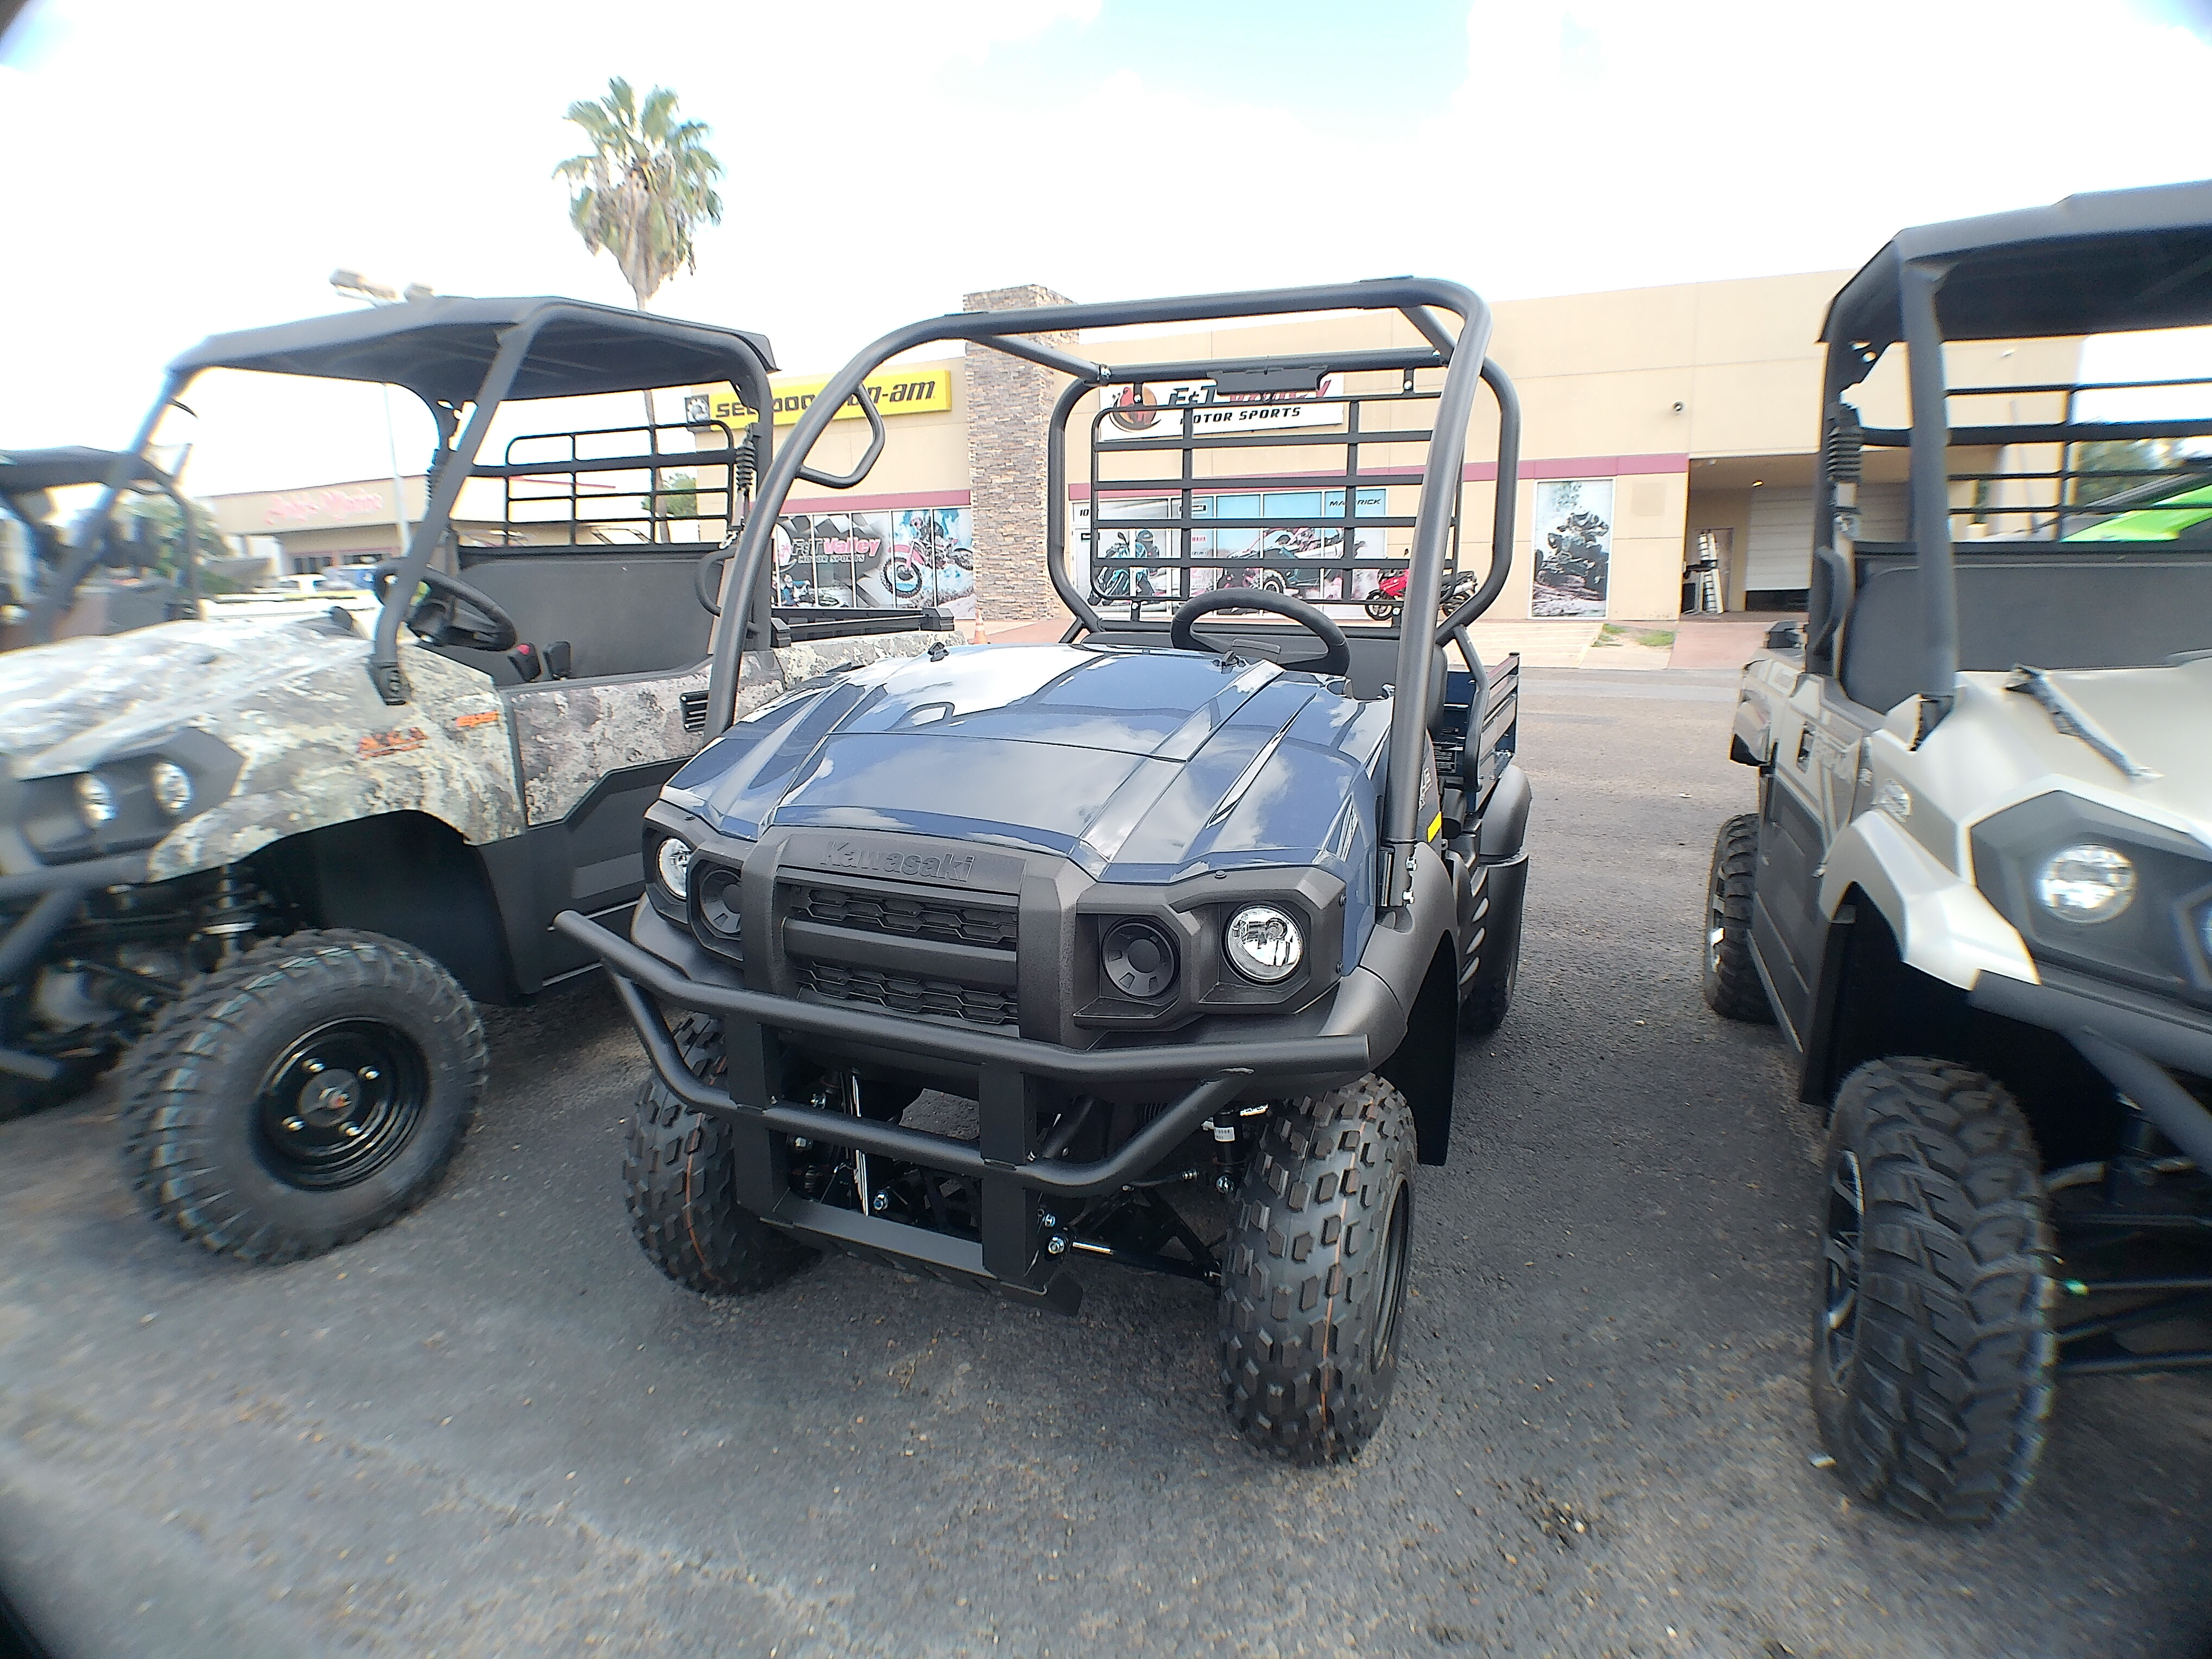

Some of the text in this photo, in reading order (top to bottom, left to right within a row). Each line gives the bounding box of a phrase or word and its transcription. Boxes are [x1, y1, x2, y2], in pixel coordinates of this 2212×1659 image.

[847, 380, 935, 407] n-am
[1180, 407, 1301, 425] OTOR SPORTS
[1329, 498, 1381, 506] MARICK
[820, 841, 975, 882] Kawasaki
